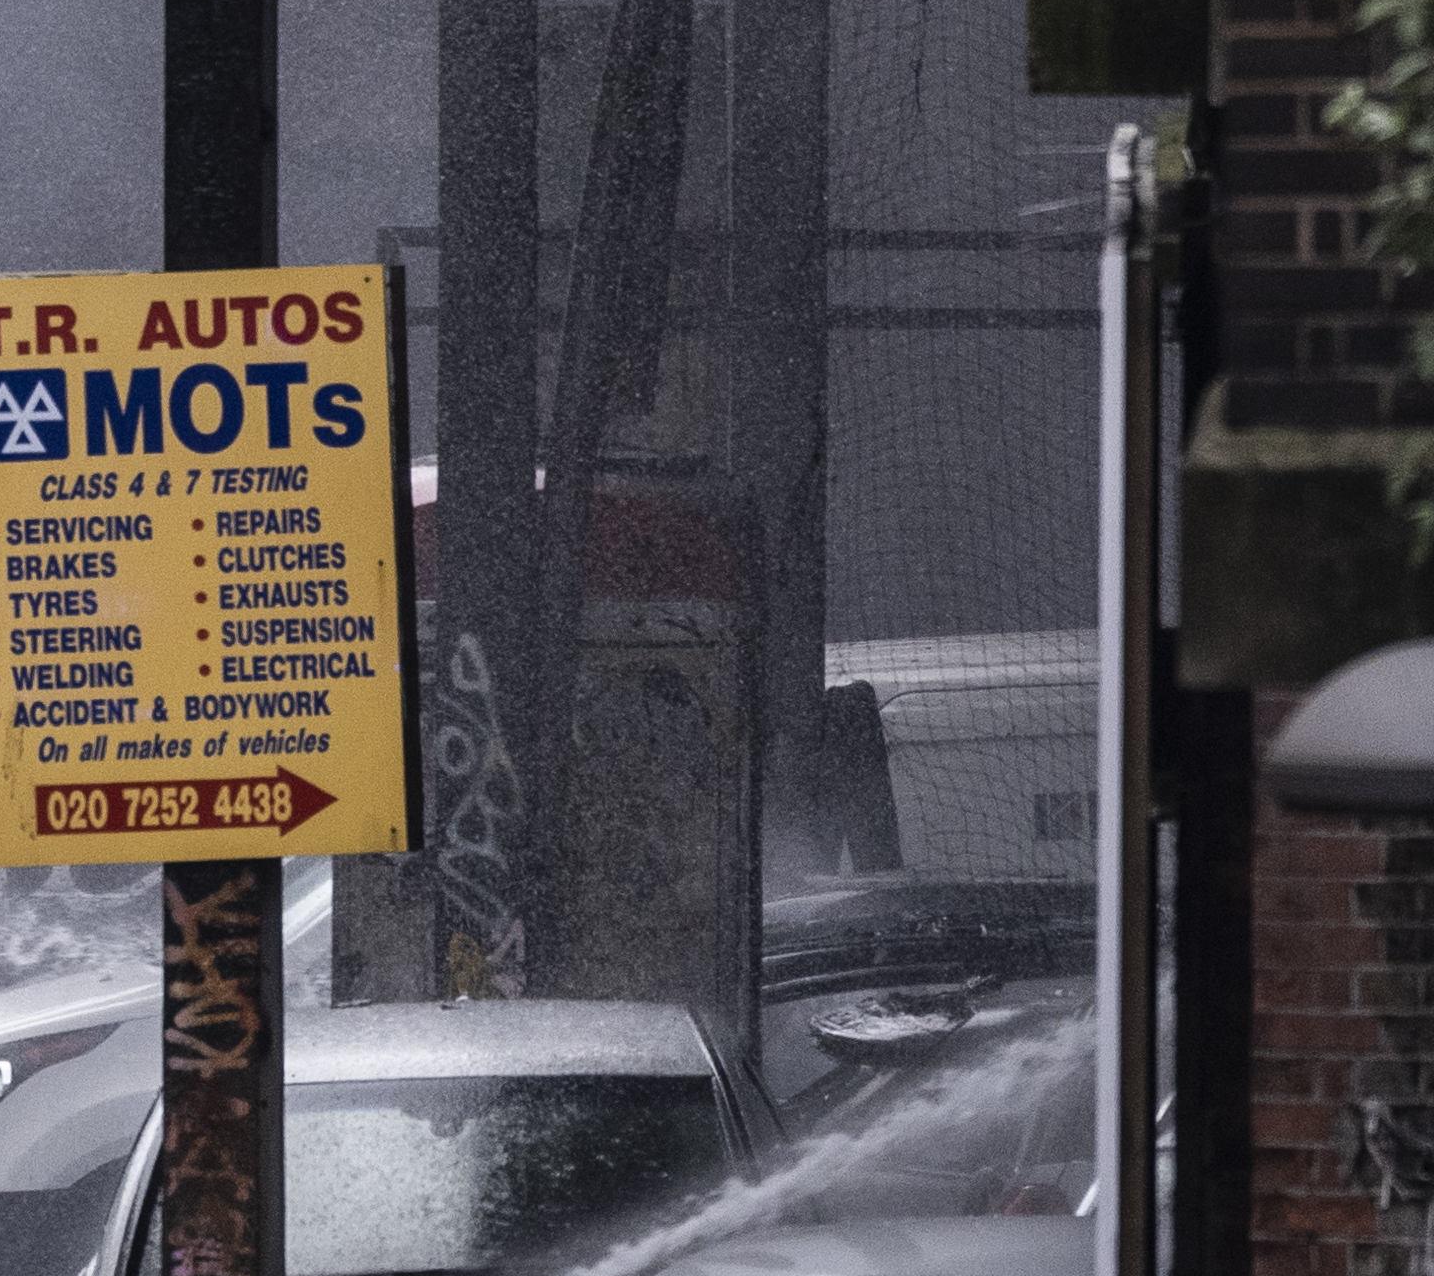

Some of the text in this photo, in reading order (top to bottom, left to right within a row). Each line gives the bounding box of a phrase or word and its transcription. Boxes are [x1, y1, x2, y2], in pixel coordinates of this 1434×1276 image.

[138, 291, 365, 351] AUTOS
[83, 362, 366, 457] MOTs
[40, 465, 308, 502] CLASS 4 & 7 TESTING
[6, 515, 153, 546] SERVICING
[216, 507, 321, 537] REPAIRS
[7, 551, 117, 582] BRAKES
[217, 543, 346, 573] CLUTCHES
[10, 589, 98, 618] TYRES
[219, 580, 349, 610] EXHAUSTS
[10, 625, 142, 655] STEERING
[221, 616, 375, 647] SUSPENSION
[12, 661, 133, 692] WELDING
[222, 652, 376, 684] ELECTRICAL
[13, 691, 330, 728] ACCIDENT & BODYWORK
[39, 728, 330, 763] On all makes of vehicles
[47, 782, 293, 830] 020 7252 4438
